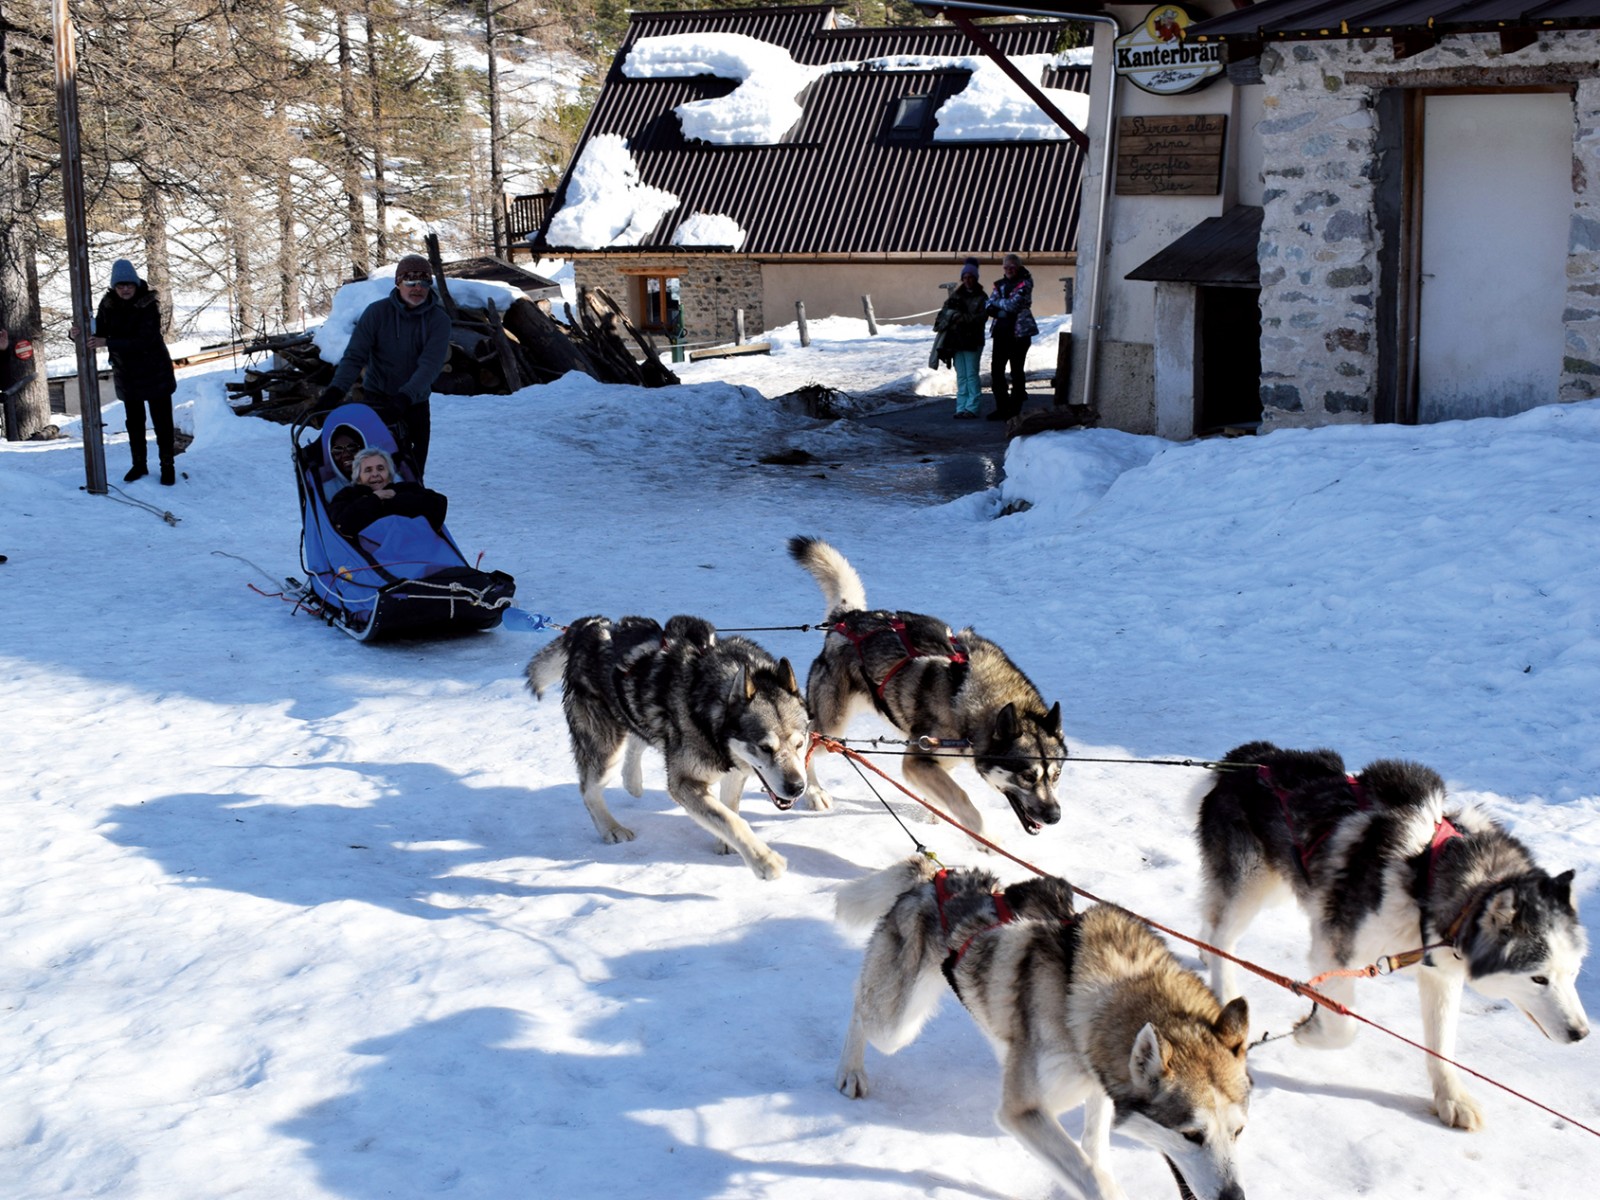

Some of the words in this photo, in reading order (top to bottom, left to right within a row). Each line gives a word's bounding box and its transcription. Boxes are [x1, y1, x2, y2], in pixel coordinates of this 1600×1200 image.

[1117, 43, 1219, 69] Kanterbräu
[1132, 116, 1180, 136] Birra
[1185, 115, 1217, 131] alla
[1145, 139, 1190, 154] spina
